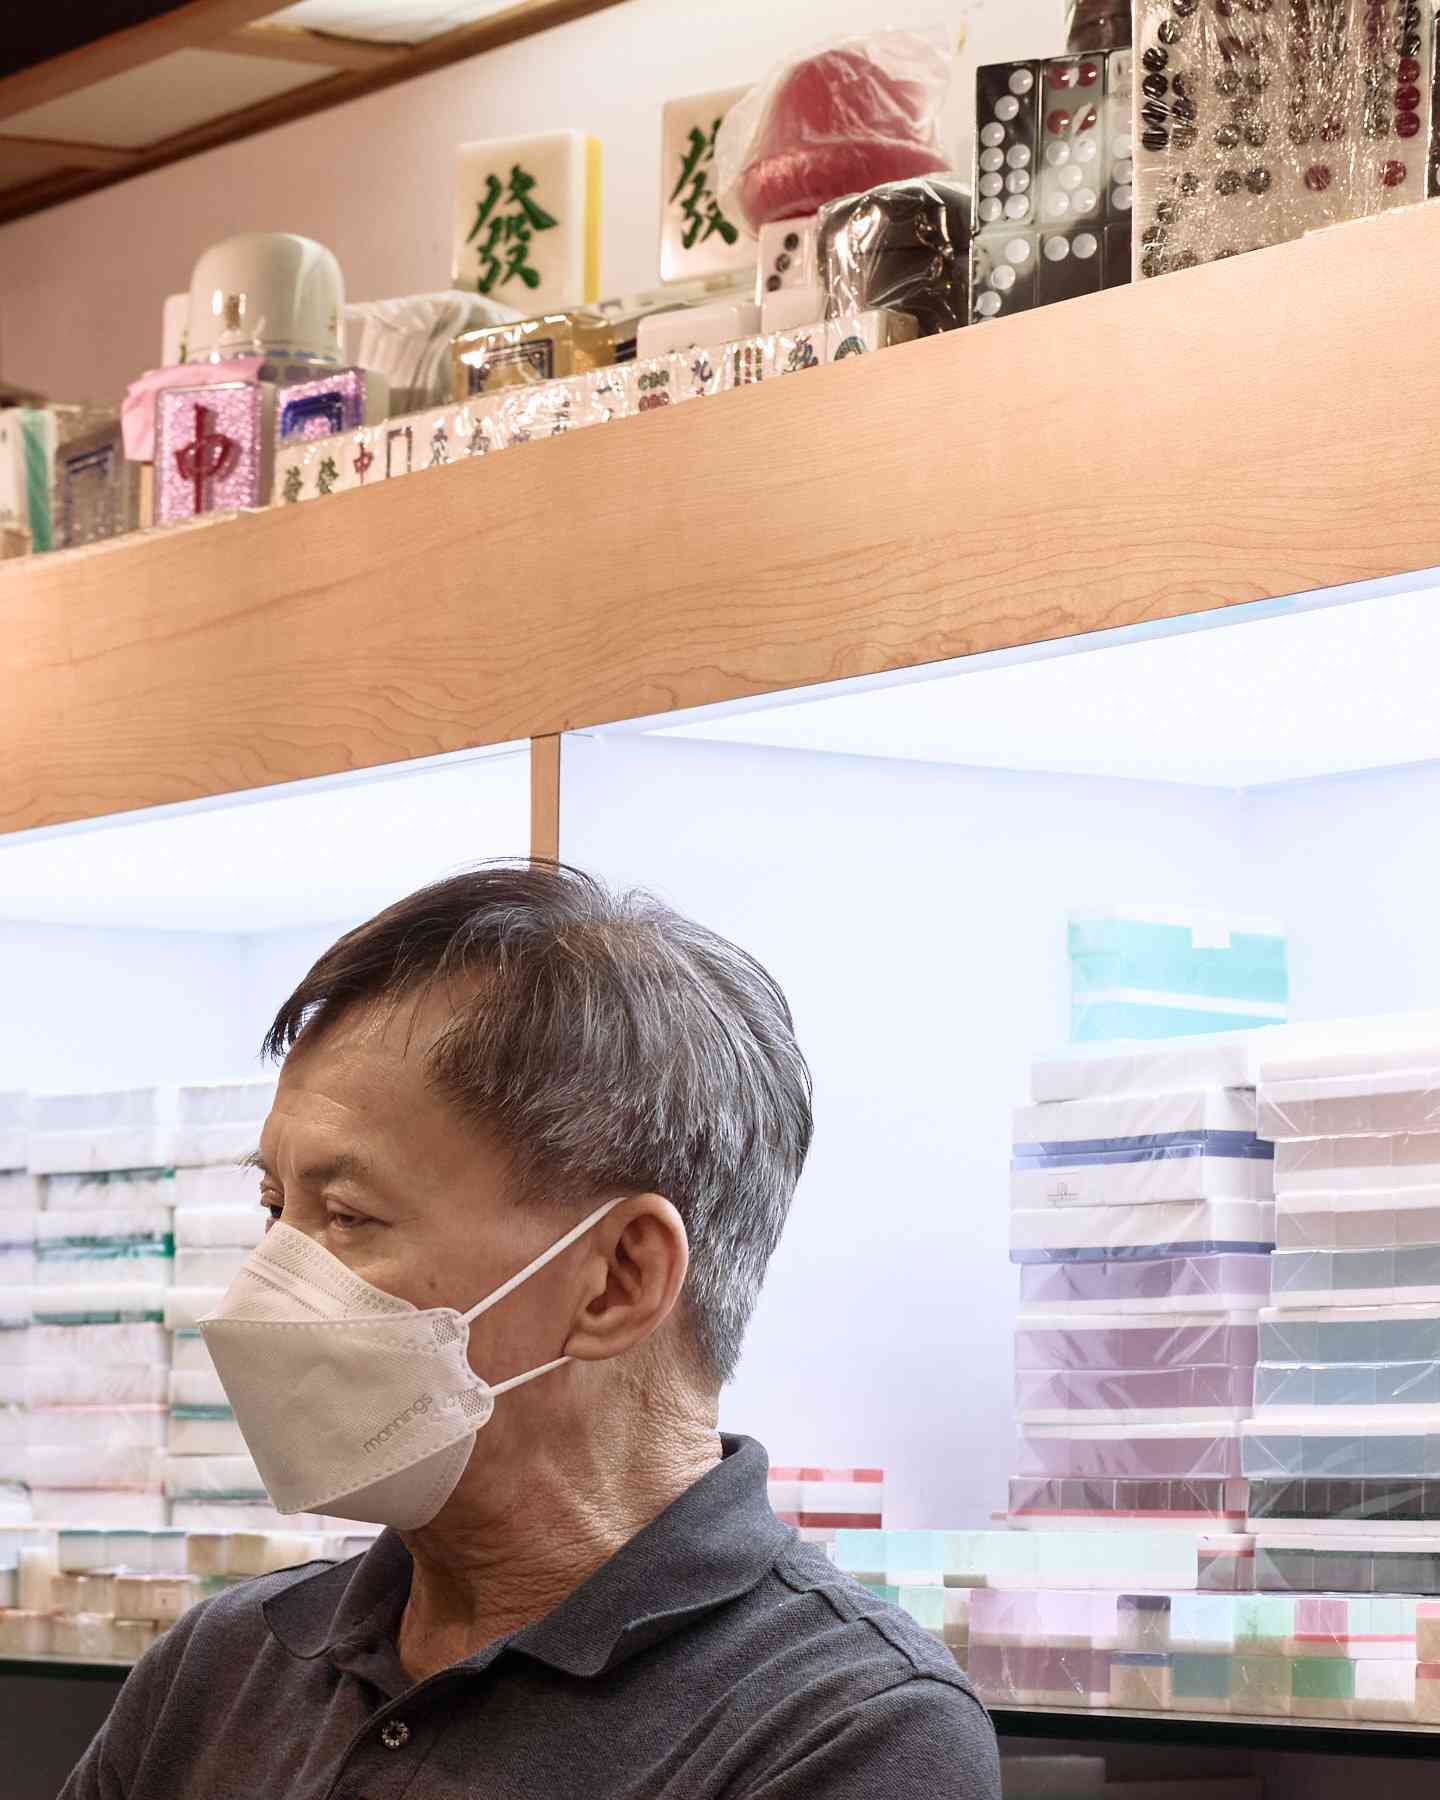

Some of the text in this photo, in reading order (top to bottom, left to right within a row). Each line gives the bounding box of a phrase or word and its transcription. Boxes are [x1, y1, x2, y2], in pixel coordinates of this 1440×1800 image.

[468, 164, 557, 293] 發
[174, 402, 233, 515] 中
[362, 1393, 433, 1454] mannings
